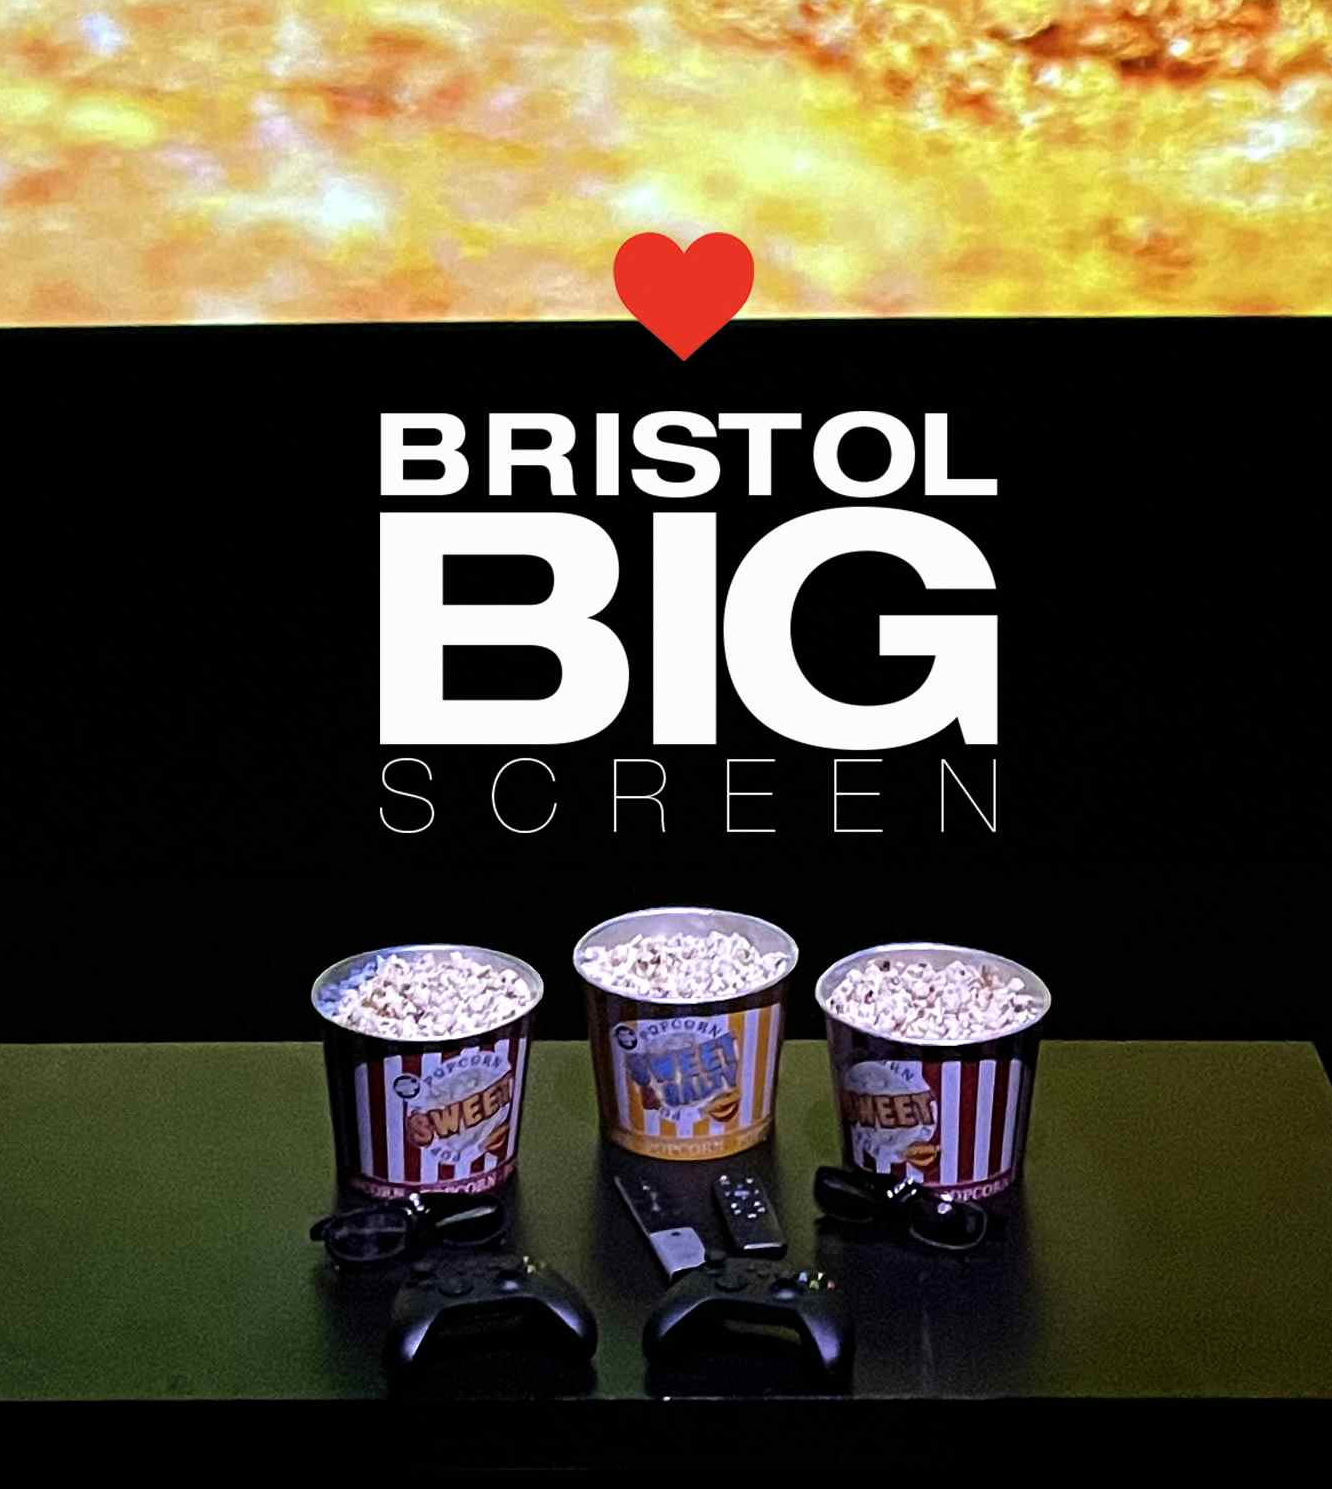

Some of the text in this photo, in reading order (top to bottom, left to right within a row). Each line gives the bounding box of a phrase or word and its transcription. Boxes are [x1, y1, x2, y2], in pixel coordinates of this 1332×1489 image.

[640, 1018, 721, 1040] POPCORN
[423, 1055, 503, 1086] POPCORN
[408, 1077, 511, 1147] SWEET
